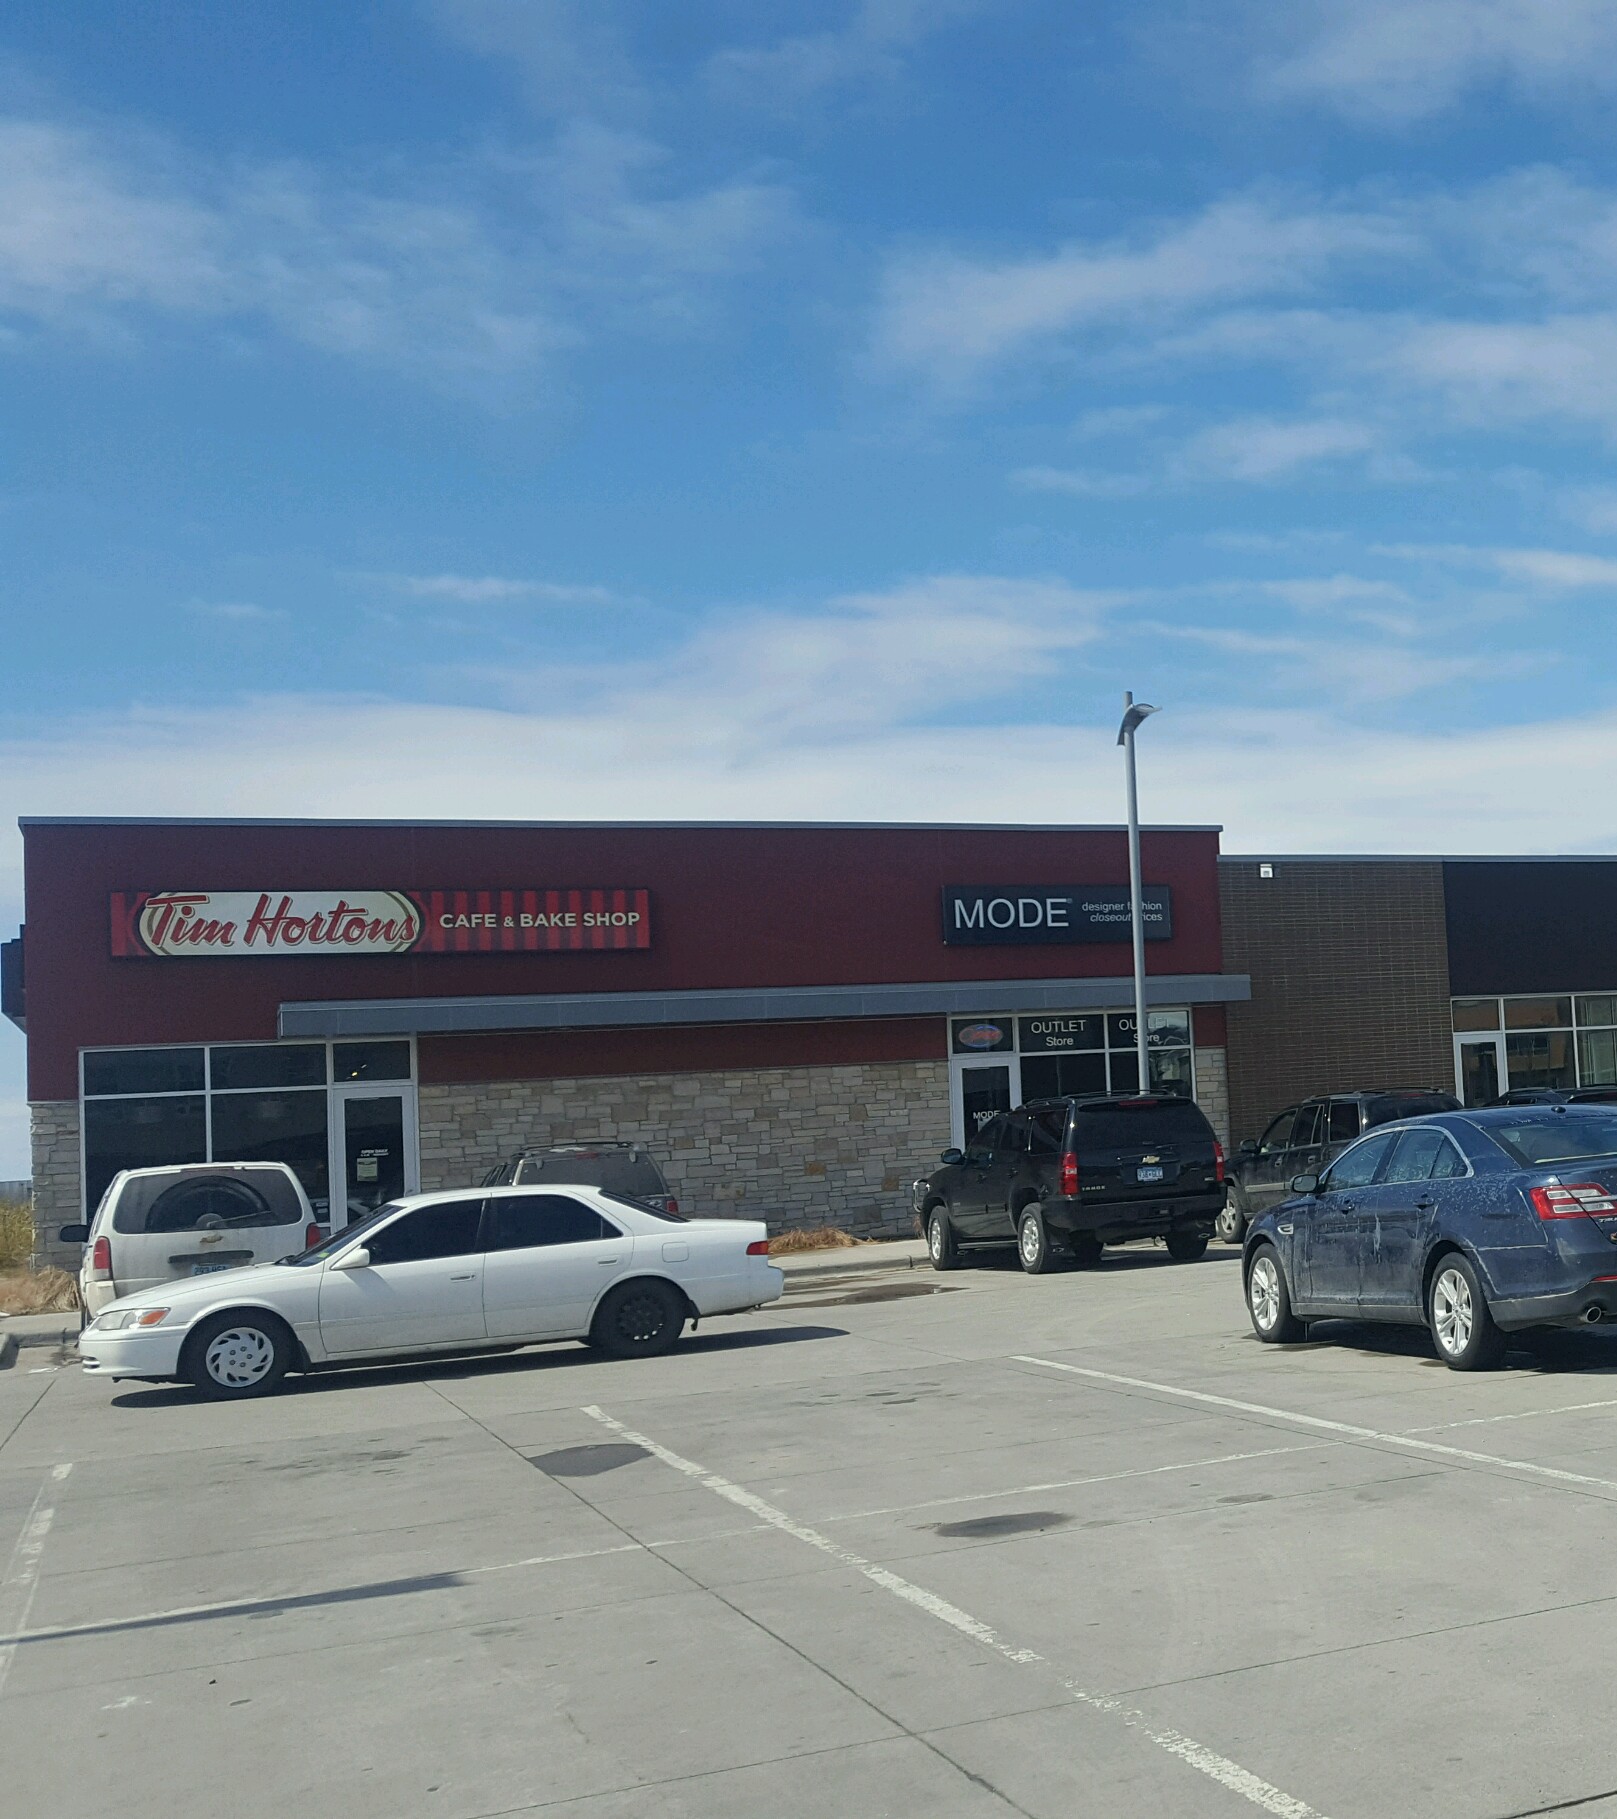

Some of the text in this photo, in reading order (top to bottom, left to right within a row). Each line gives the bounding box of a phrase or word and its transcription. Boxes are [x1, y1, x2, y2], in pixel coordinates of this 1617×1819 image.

[954, 898, 1069, 928] MODE
[1082, 902, 1125, 913] designer
[147, 893, 417, 946] Tim Hortons
[439, 912, 640, 928] CAFE & BAKE SHOP
[1090, 913, 1131, 922] closeout
[1031, 1020, 1086, 1033] OUTLET
[1119, 1017, 1170, 1030] OULET
[1046, 1036, 1074, 1046] Store
[1133, 1033, 1160, 1042] Sore
